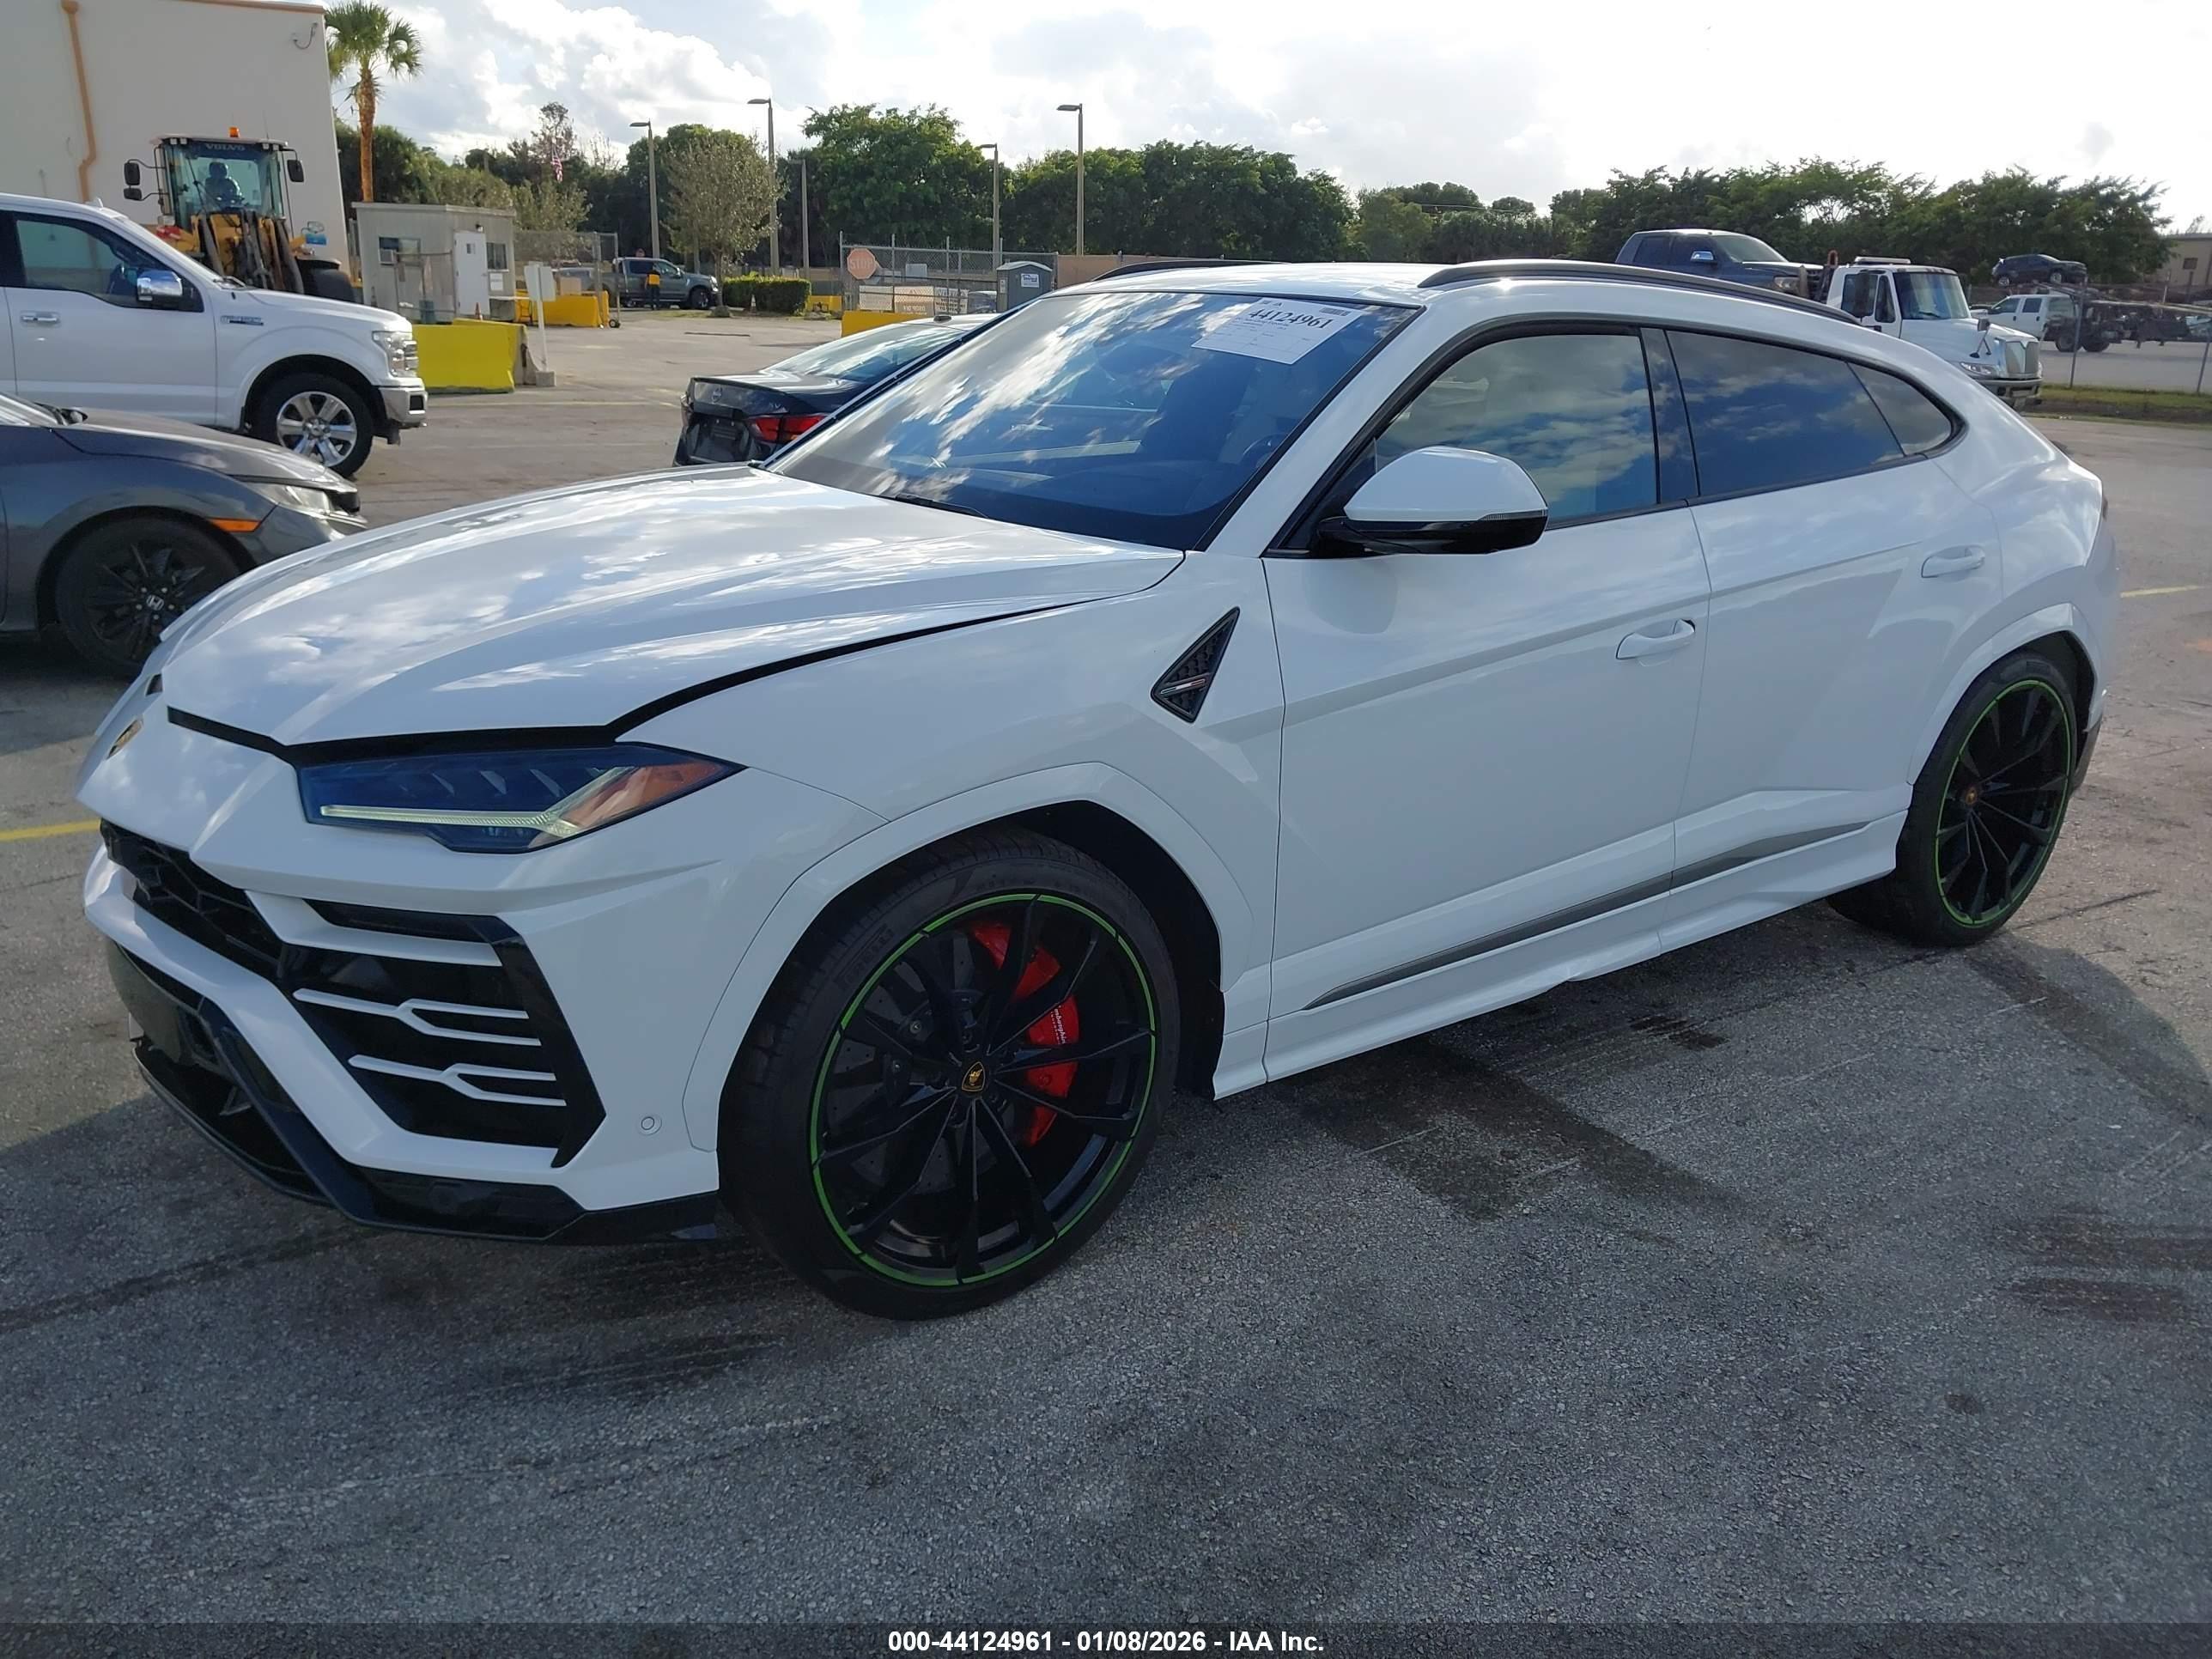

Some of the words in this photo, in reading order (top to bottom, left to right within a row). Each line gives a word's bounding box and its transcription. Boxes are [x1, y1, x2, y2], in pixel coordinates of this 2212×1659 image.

[205, 143, 246, 151] VOLVO
[849, 258, 873, 270] STOP
[1248, 308, 1334, 329] 44124961
